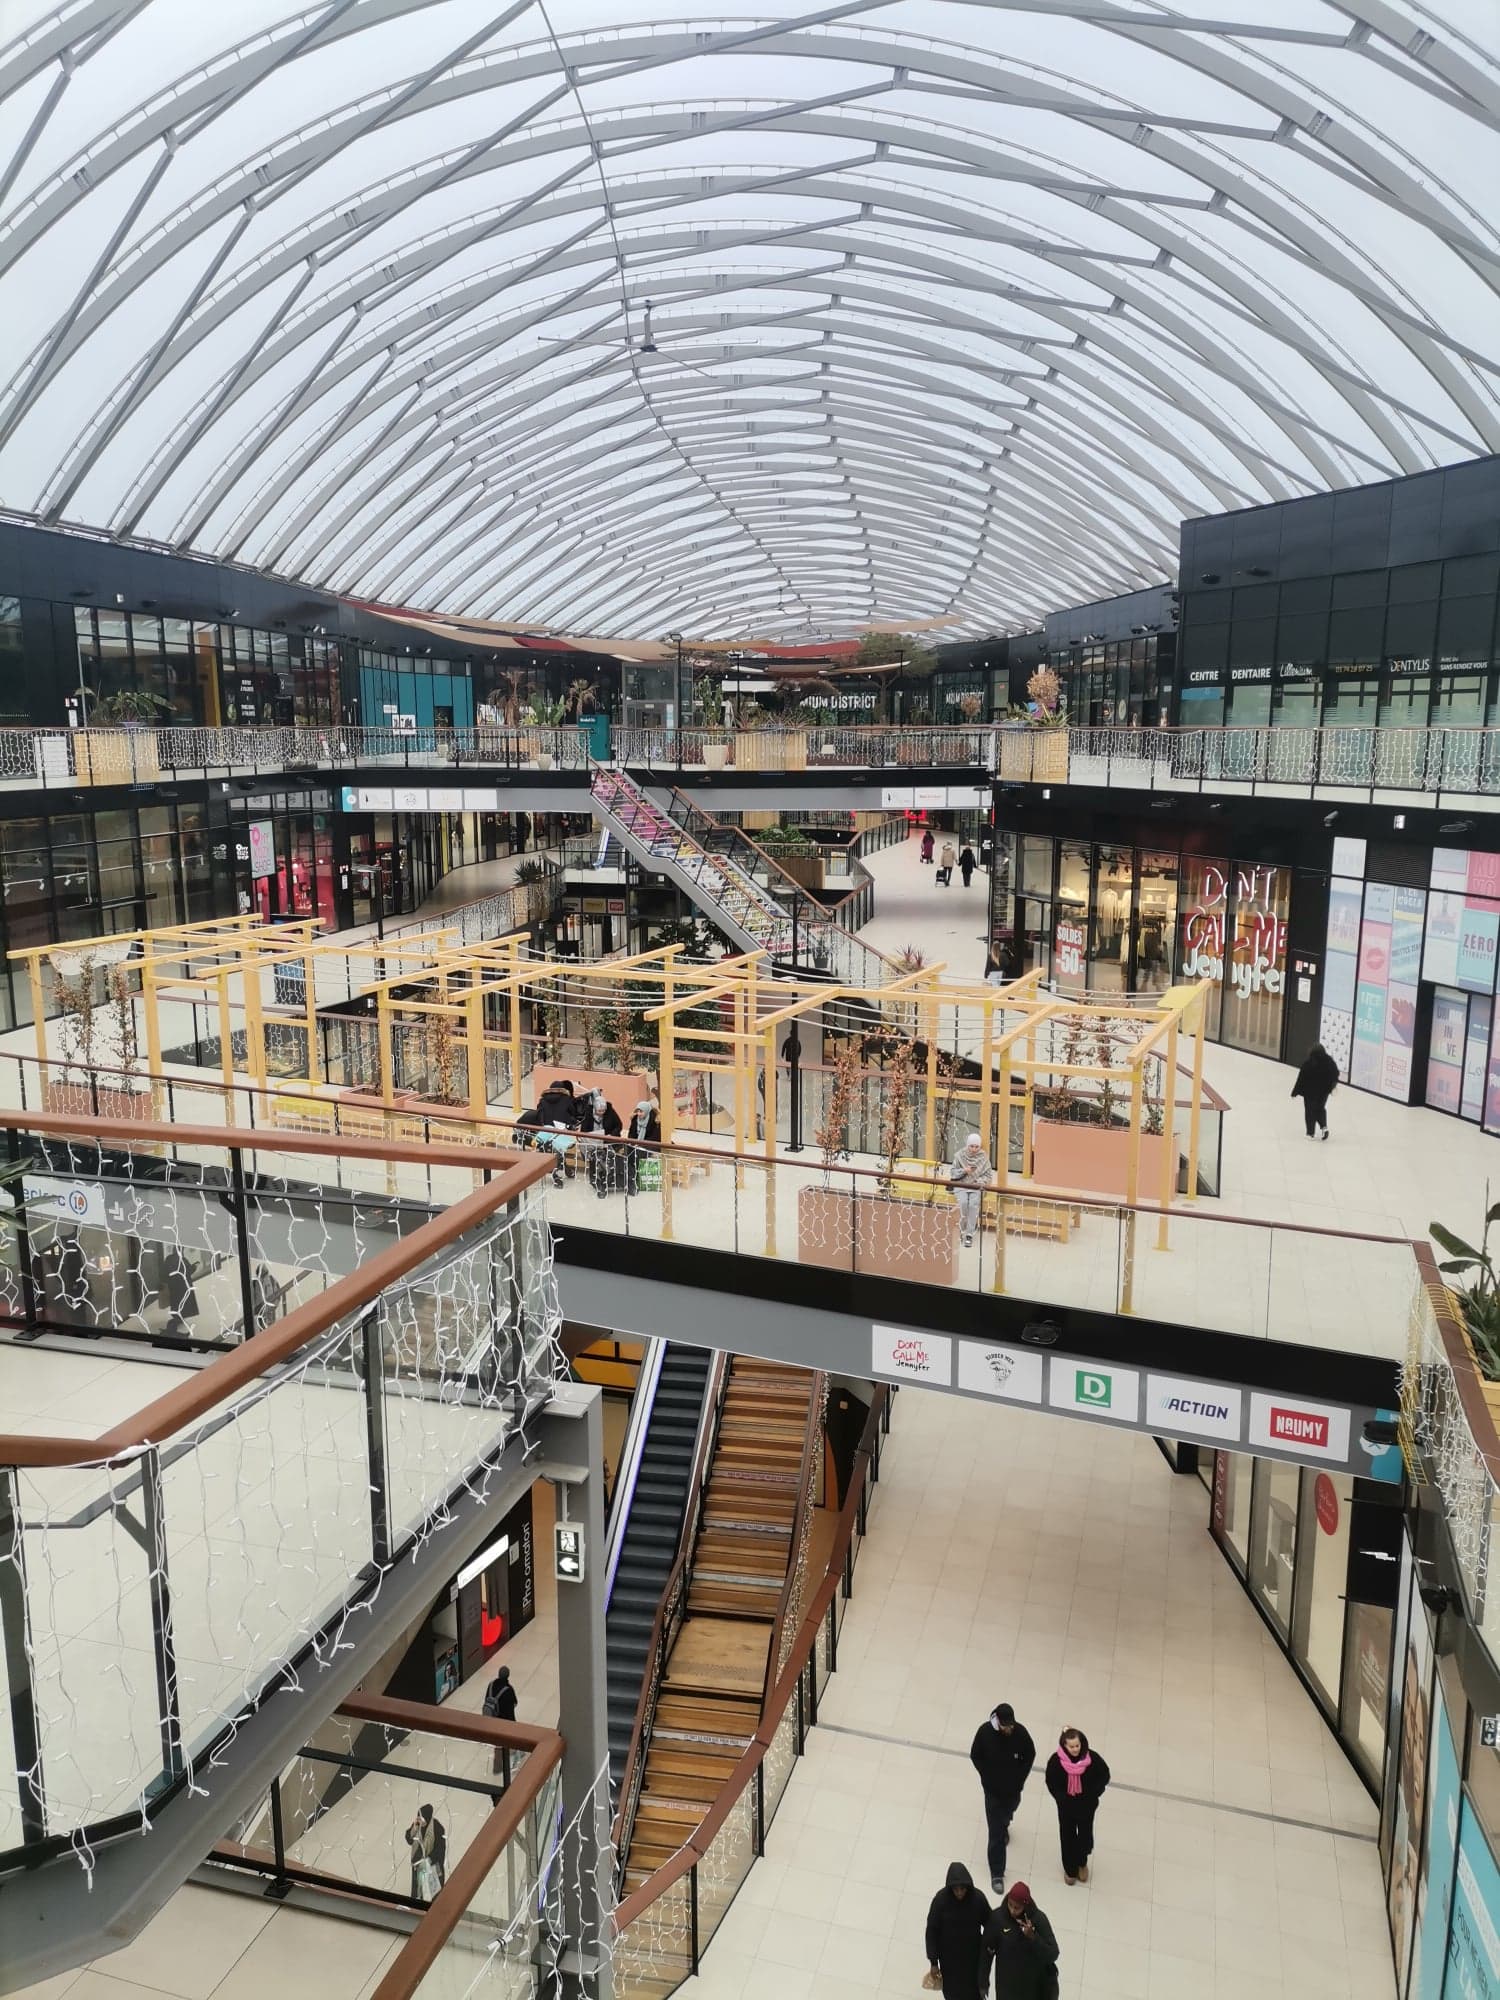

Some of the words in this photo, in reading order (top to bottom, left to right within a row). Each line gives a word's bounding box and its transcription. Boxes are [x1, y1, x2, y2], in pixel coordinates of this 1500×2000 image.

[1390, 658, 1430, 673] DENTYLIS
[1190, 671, 1219, 681] CENTRE
[1231, 668, 1271, 680] DENTAIRE
[831, 694, 876, 709] DISTRICT
[1056, 925, 1083, 945] SOLDES
[1463, 934, 1495, 953] ZERO
[892, 1349, 915, 1362] CALL
[916, 1351, 930, 1363] ME
[896, 1359, 930, 1372] Jennyfer
[1084, 1375, 1106, 1399] D
[1168, 1398, 1229, 1420] ACTION
[1276, 1415, 1323, 1441] NAUMY
